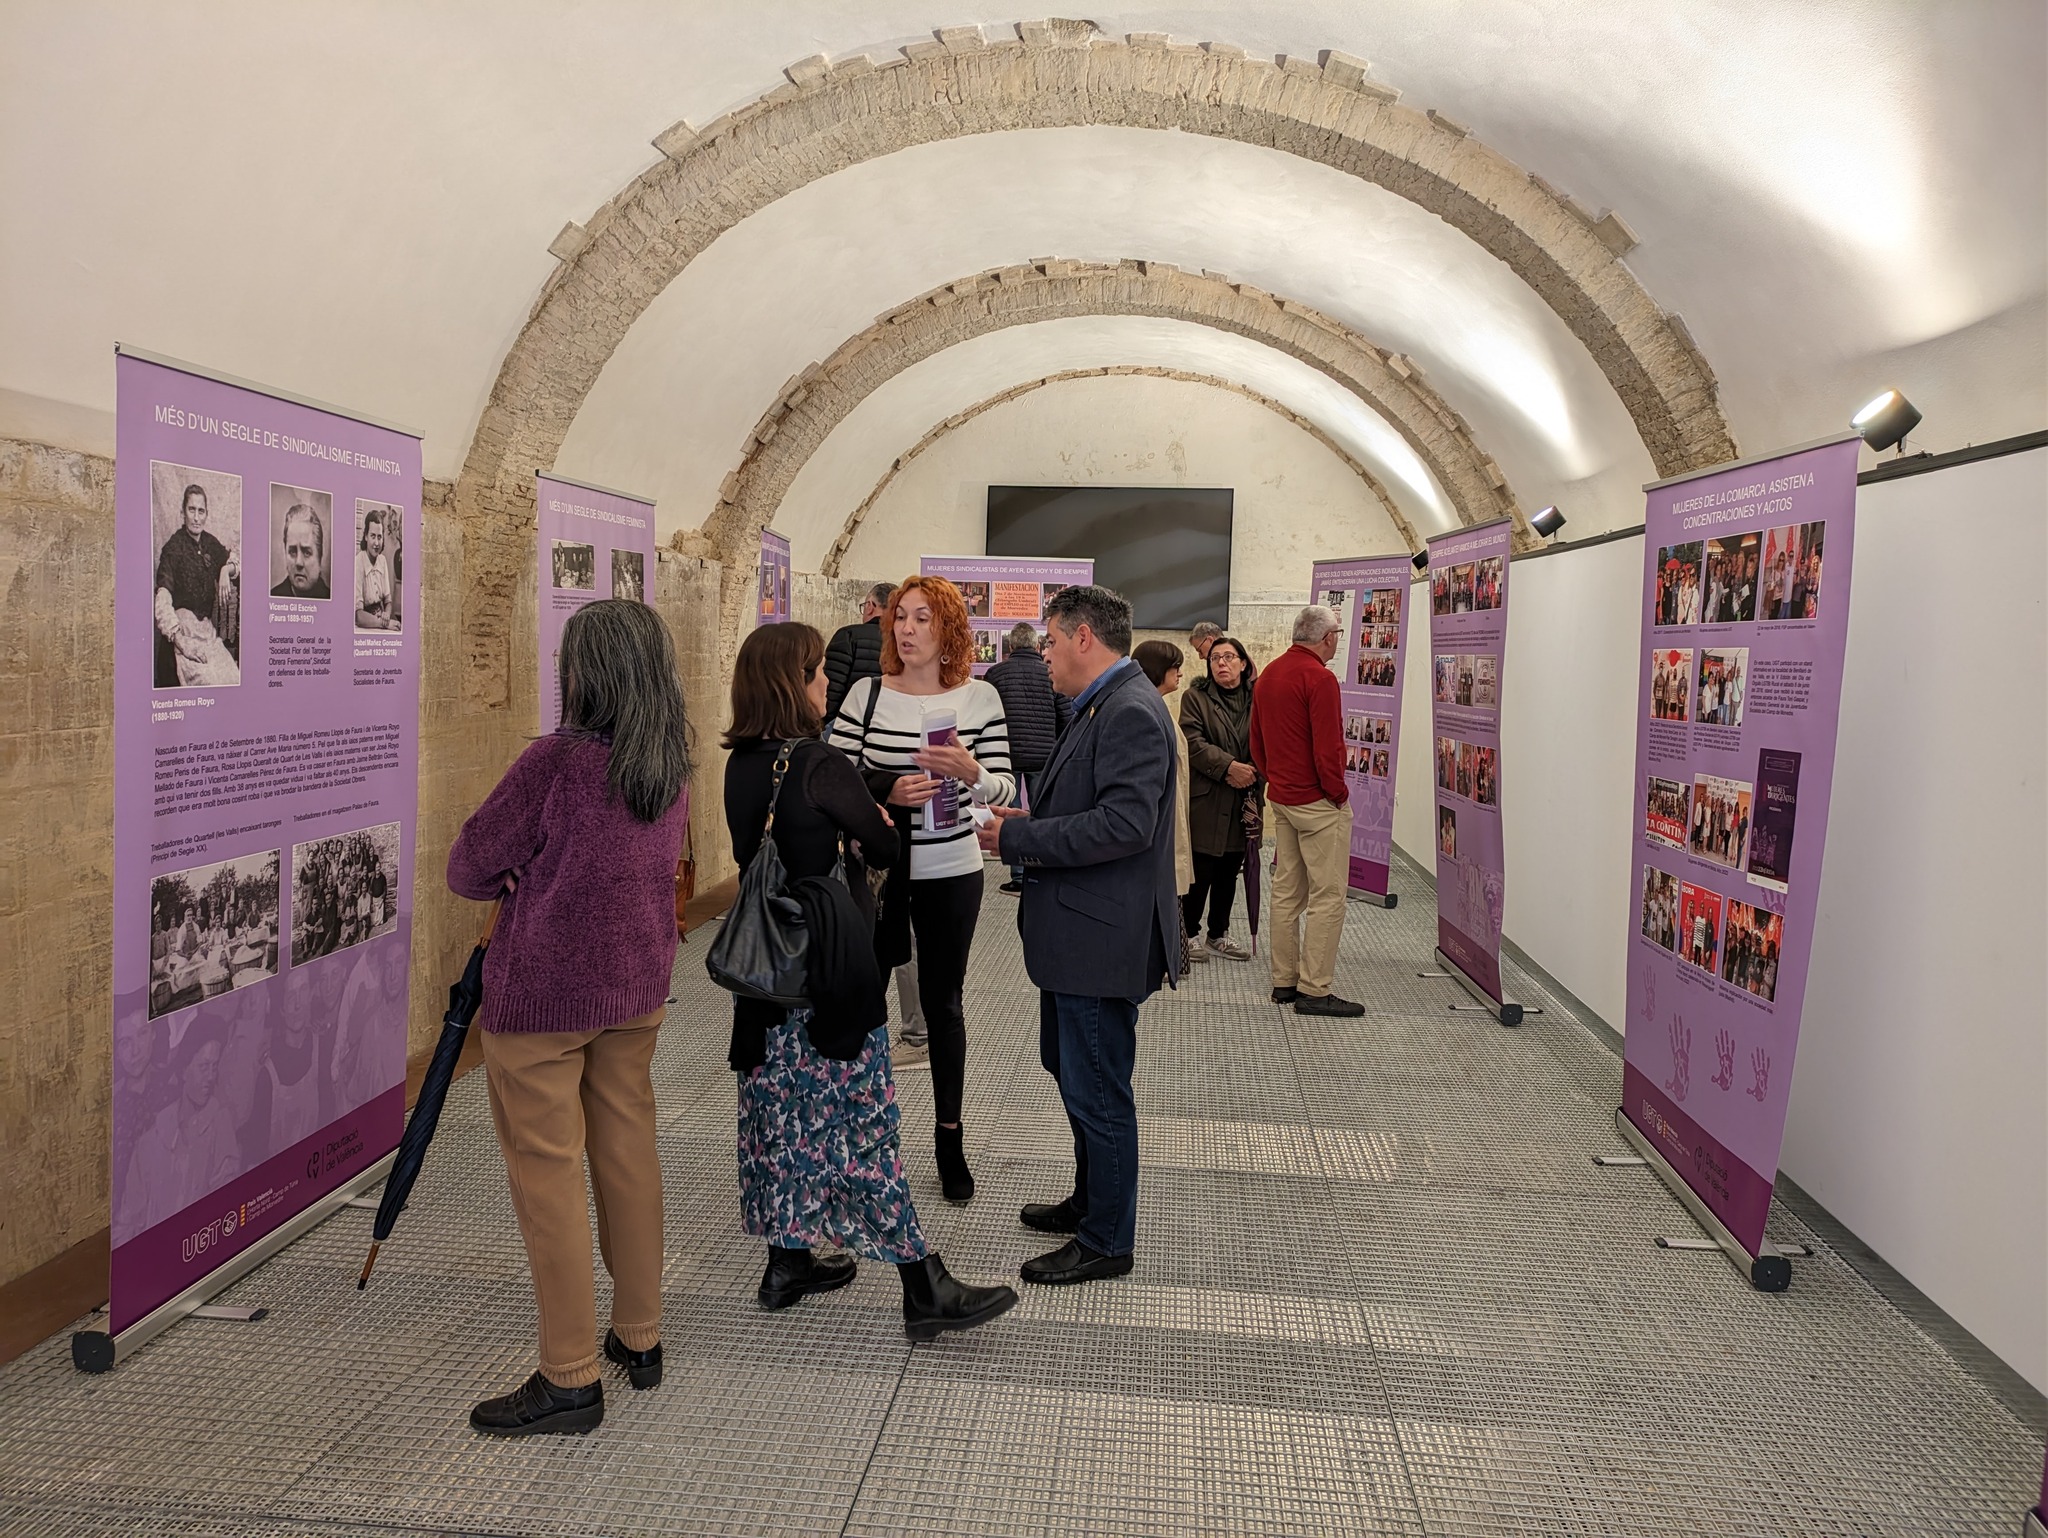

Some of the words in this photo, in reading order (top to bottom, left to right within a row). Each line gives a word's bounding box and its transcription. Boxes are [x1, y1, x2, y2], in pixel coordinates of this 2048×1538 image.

[156, 405, 185, 427] MÉS
[222, 421, 260, 444] SEGLE
[264, 431, 279, 448] DE
[282, 436, 352, 465] SINDICALISME
[355, 453, 400, 476] FEMINISTA
[1673, 497, 1702, 514] MUJERES
[1704, 494, 1715, 507] DE
[1716, 491, 1726, 505] LA
[1727, 483, 1766, 503] COMARCA
[1769, 474, 1806, 494] ASISTEN
[1806, 472, 1814, 485] A
[549, 499, 560, 512] MÉS
[574, 505, 589, 517] SEGLE
[590, 508, 596, 519] DE
[597, 510, 626, 525] SINDICALISME
[1683, 504, 1755, 529] CONCENTRACIONES
[1757, 503, 1763, 515] Y
[1763, 497, 1793, 513] ACTOS
[269, 614, 286, 623] (Faura
[312, 647, 331, 656] Taronger
[152, 700, 173, 709] Vicenta
[174, 699, 196, 707] Romeu
[198, 698, 214, 707] Royo
[155, 746, 177, 755] Nascuda
[188, 743, 206, 751] Faura
[208, 741, 214, 749] el
[215, 740, 219, 748] 2
[220, 740, 227, 748] de
[229, 737, 254, 746] Setembre
[255, 736, 262, 744] de
[297, 731, 312, 741] Miguel
[313, 729, 330, 737] Romeu
[388, 722, 399, 730] Royo
[186, 755, 194, 763] de
[249, 747, 265, 755] Carrer
[278, 744, 291, 752] Maria
[327, 1128, 358, 1156] Diputació
[326, 1160, 335, 1172] de
[337, 1142, 363, 1167] València
[182, 1219, 221, 1263] UGT
